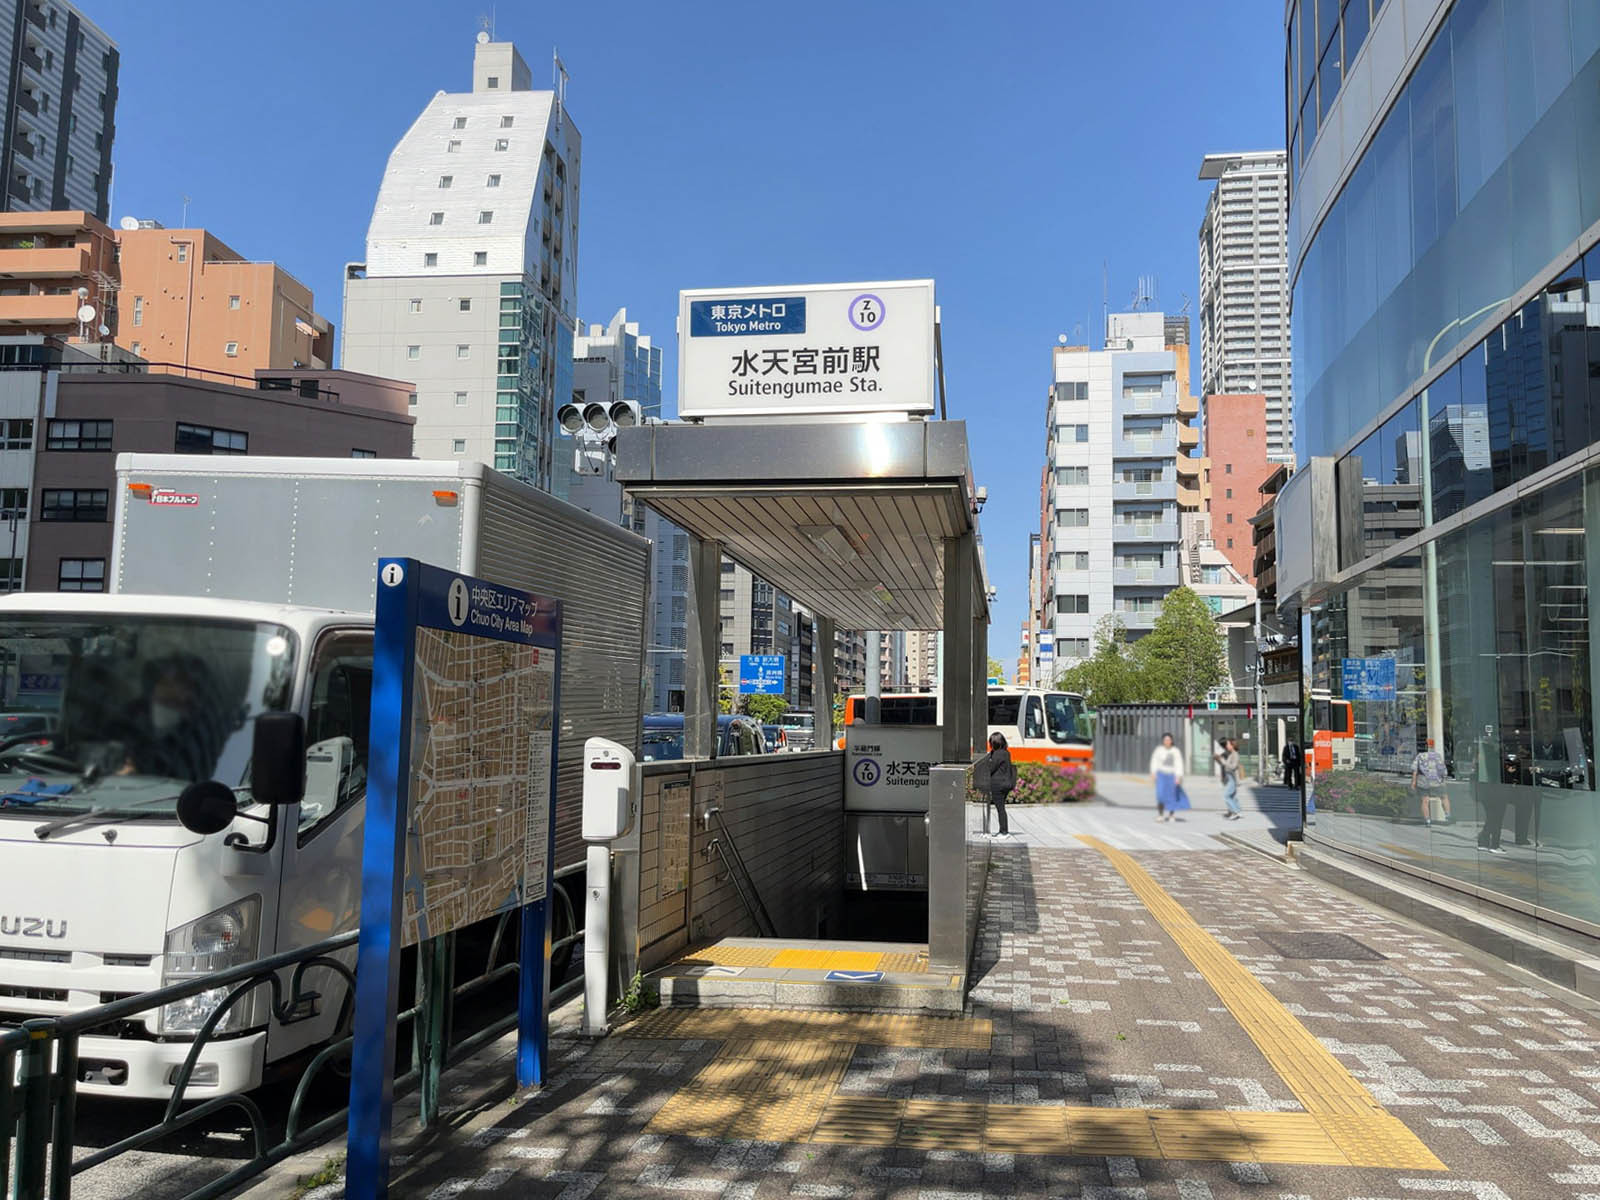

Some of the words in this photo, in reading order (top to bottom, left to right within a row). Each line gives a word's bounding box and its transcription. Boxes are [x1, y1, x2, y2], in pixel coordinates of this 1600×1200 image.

[711, 302, 786, 320] 東京メトロ
[862, 299, 871, 310] Z
[859, 311, 876, 323] 10
[715, 321, 747, 334] Tokyo
[749, 320, 781, 332] Metro
[731, 345, 880, 377] 水天宮前駅
[728, 378, 843, 399] Suitengumae
[849, 375, 883, 393] Sta.
[471, 585, 538, 617] 中央区エリアマップ
[470, 609, 490, 627] Chuo
[490, 613, 504, 632] City
[505, 616, 520, 631] Area
[520, 620, 534, 637] Map
[863, 763, 870, 771] Z
[886, 760, 940, 776] 水天宮
[861, 772, 874, 781] 10
